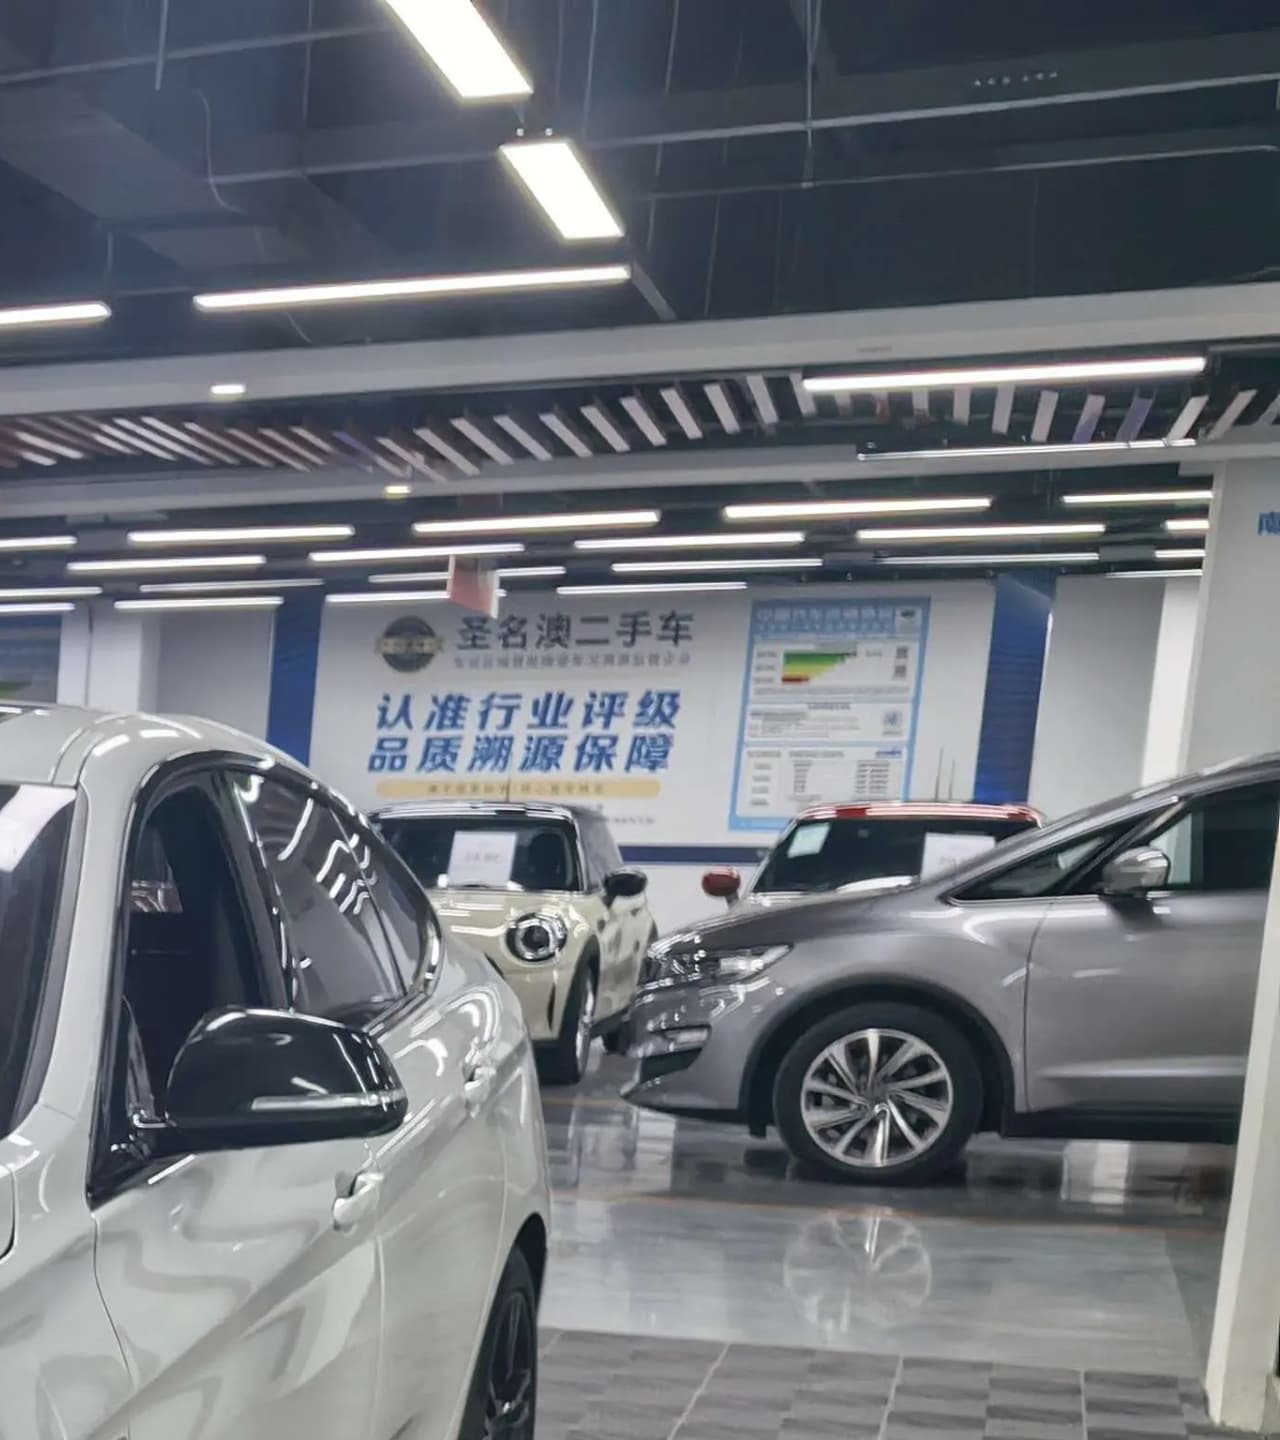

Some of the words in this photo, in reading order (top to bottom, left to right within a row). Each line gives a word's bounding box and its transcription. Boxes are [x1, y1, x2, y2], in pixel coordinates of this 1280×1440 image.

[457, 610, 695, 651] 圣名澳二手车
[376, 690, 681, 731] 认准行业评级
[367, 732, 674, 773] 品质溯源保障
